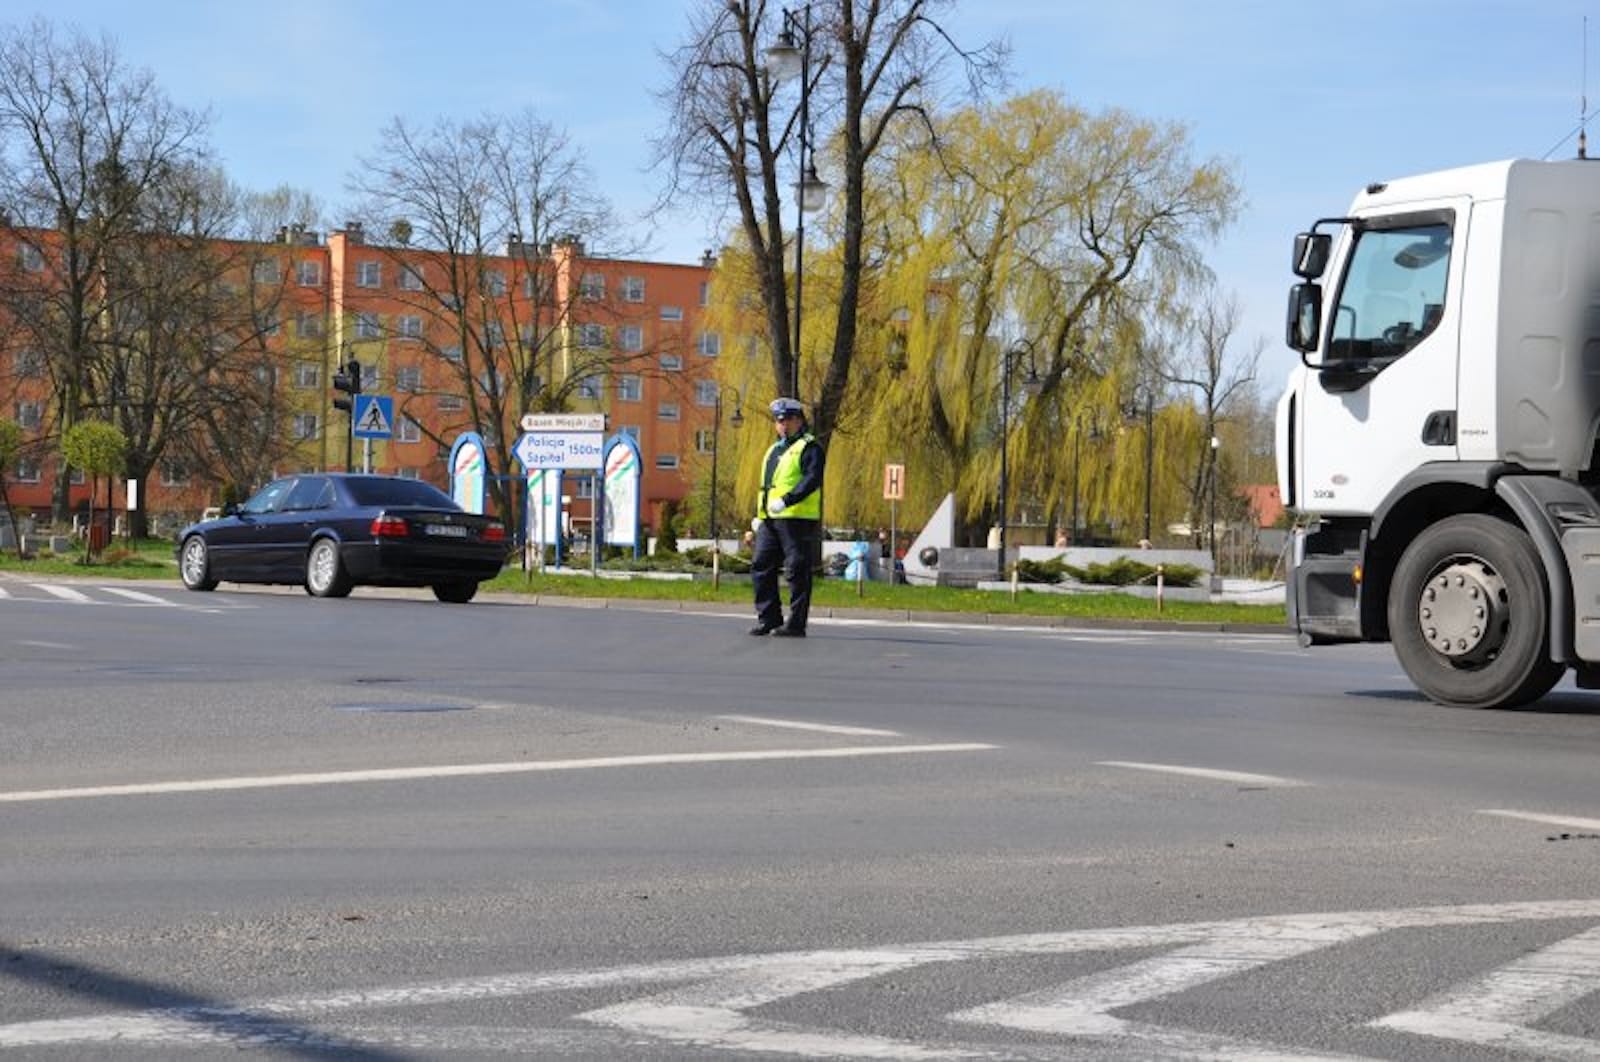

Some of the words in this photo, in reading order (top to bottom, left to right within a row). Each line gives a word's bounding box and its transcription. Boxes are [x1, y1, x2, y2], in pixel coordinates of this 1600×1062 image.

[527, 435, 565, 448] Policja
[569, 444, 600, 456] 1500m
[527, 452, 565, 465] Szpital
[888, 468, 899, 495] H
